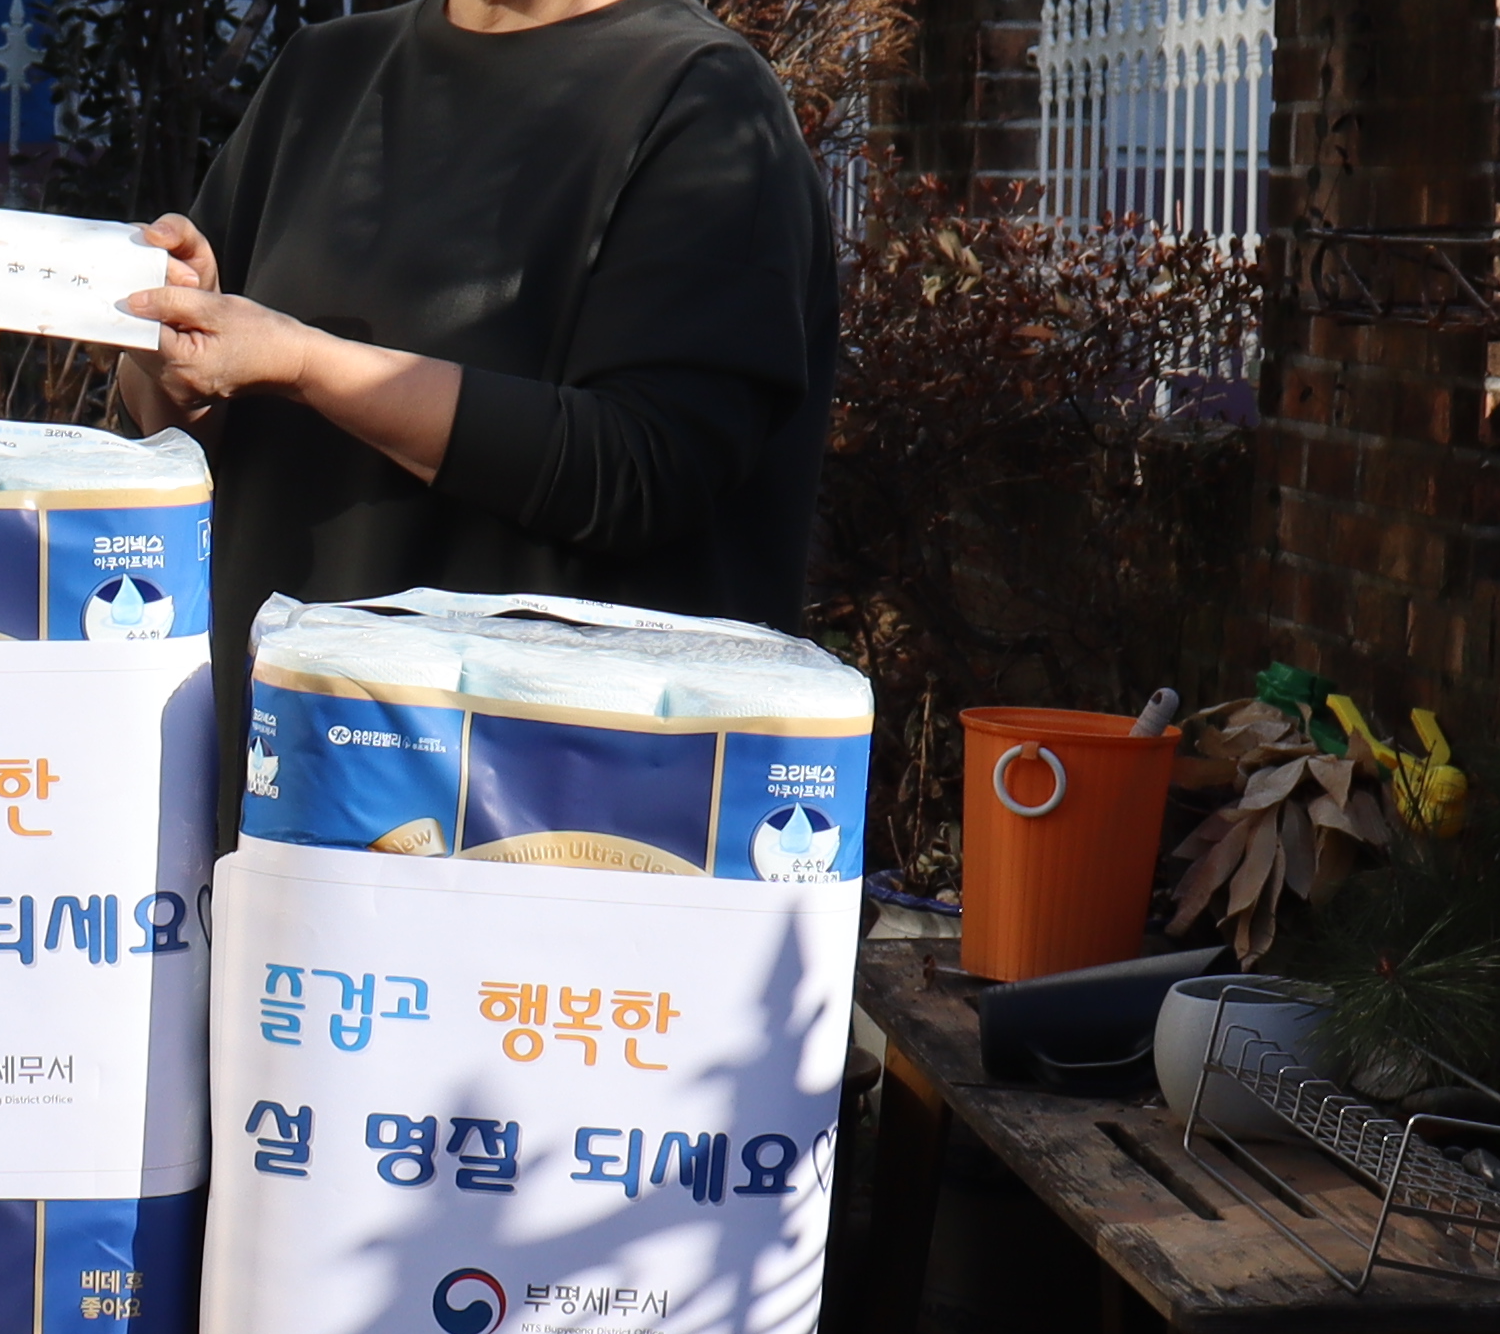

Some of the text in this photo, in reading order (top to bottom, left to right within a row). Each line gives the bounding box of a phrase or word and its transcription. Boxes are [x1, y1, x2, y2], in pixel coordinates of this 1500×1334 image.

[93, 535, 164, 554] 크리넥스
[94, 555, 164, 570] 아쿠아프레시
[352, 727, 401, 748] 유한킴벌리
[768, 764, 837, 783] 크리넥스
[768, 783, 835, 799] 아쿠아프레시
[570, 841, 625, 866] Ultra
[791, 858, 826, 872] 순수한
[260, 963, 681, 1070] 즐겁고 행복한
[6, 1094, 40, 1105] District
[43, 1094, 73, 1105] Office
[245, 1100, 799, 1205] 설 명절 되세요
[80, 1271, 144, 1292] 비데 후
[80, 1296, 142, 1321] 좋아요
[523, 1282, 669, 1319] 부평세무서
[521, 1322, 541, 1334] NTS
